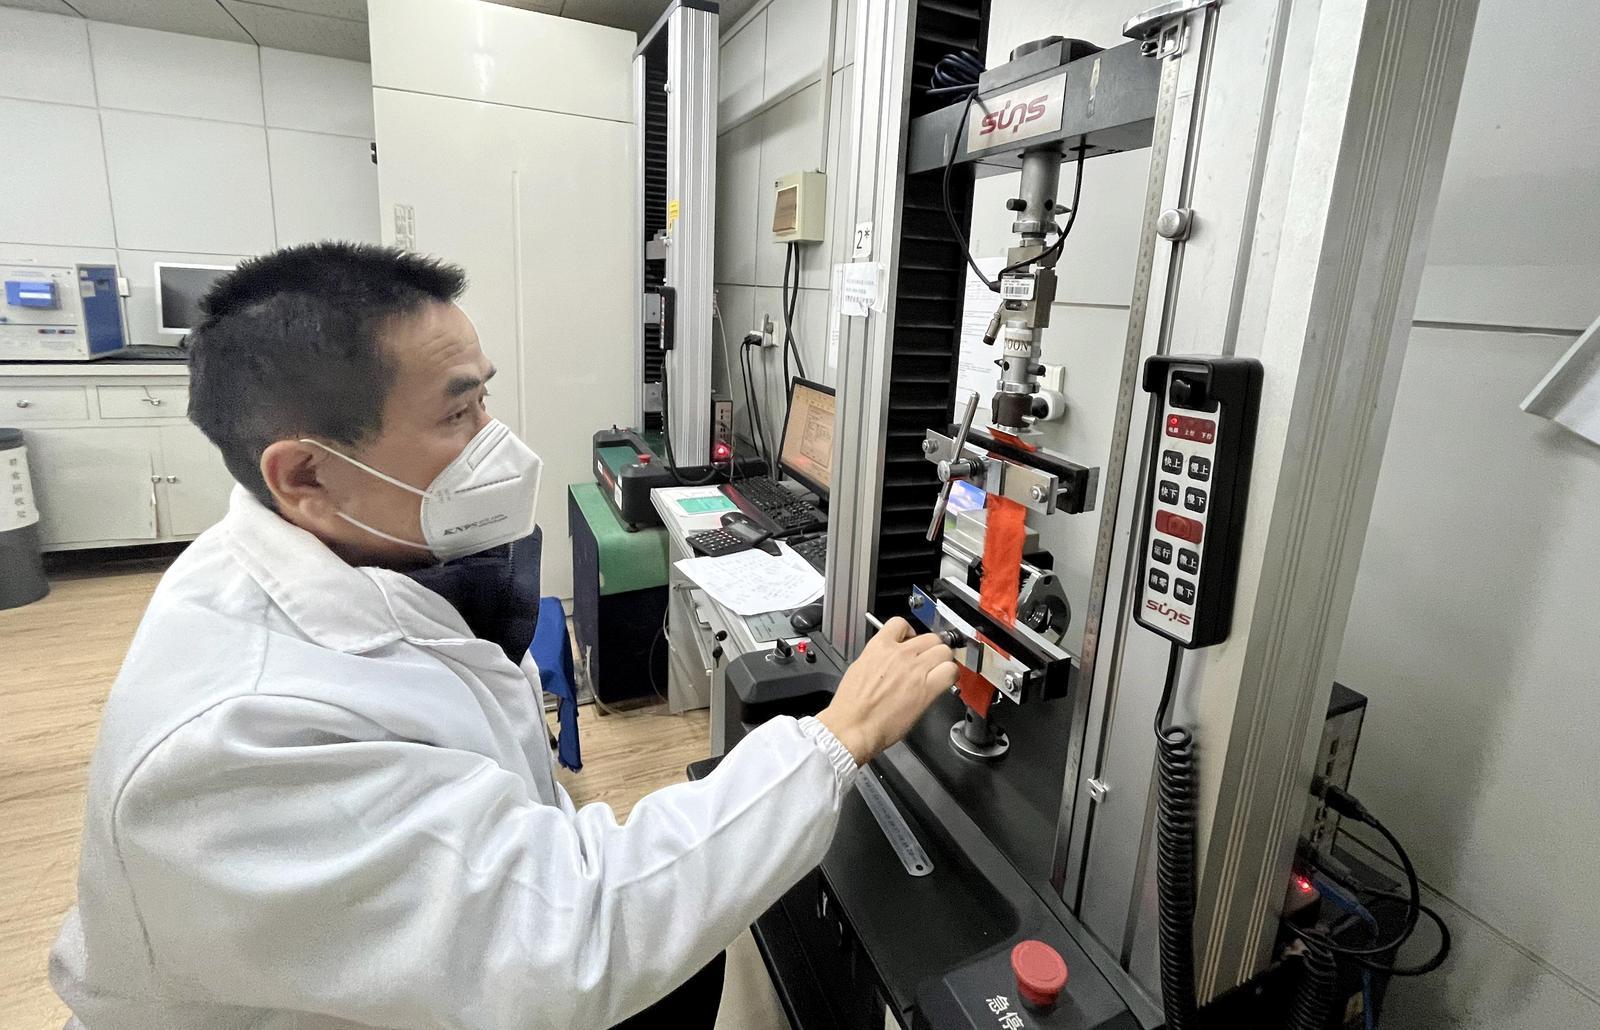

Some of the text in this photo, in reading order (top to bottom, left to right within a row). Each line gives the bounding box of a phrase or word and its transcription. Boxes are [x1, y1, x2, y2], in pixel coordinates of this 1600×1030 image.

[1164, 456, 1181, 469] 快上
[1190, 462, 1208, 475] 慢上
[1161, 485, 1178, 499] 快下
[1187, 493, 1205, 507] 慢下
[1154, 546, 1171, 559] 运行
[986, 995, 1024, 1030] 急停
